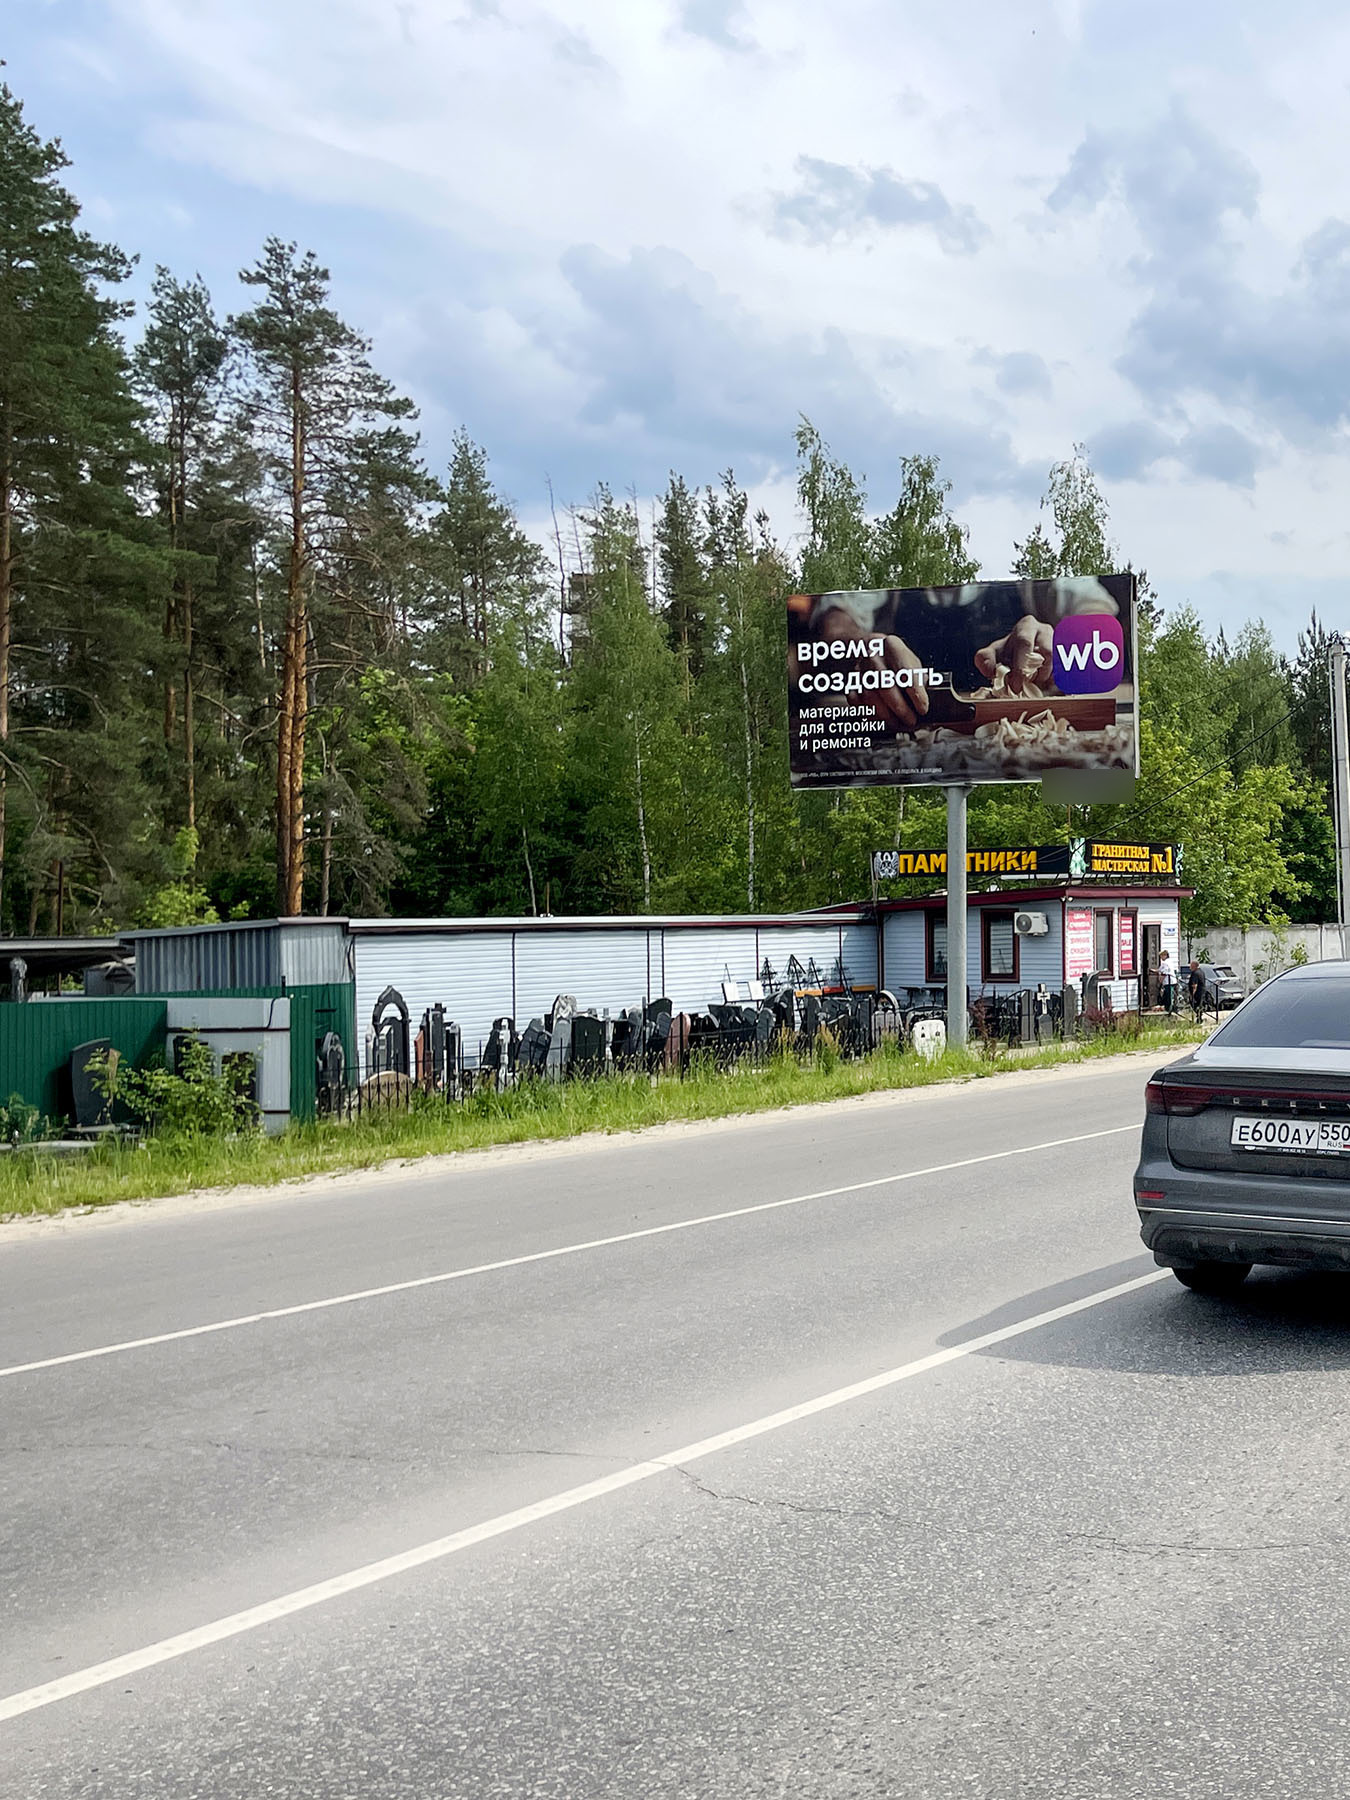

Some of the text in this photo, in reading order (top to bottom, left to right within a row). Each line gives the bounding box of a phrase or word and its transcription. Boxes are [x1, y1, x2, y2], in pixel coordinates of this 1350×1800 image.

[797, 638, 885, 667] время
[1056, 630, 1120, 671] wb
[798, 667, 944, 695] создавать
[799, 705, 876, 720] материалы
[799, 719, 885, 737] для стройки
[800, 736, 871, 753] и ремонта
[1091, 843, 1150, 859] ГРАНИТНАЯ
[899, 850, 1038, 874] ПАМТНИКИ
[1091, 858, 1150, 873] МАСТЕРСКАЯ
[1327, 1140, 1343, 1149] RUS
